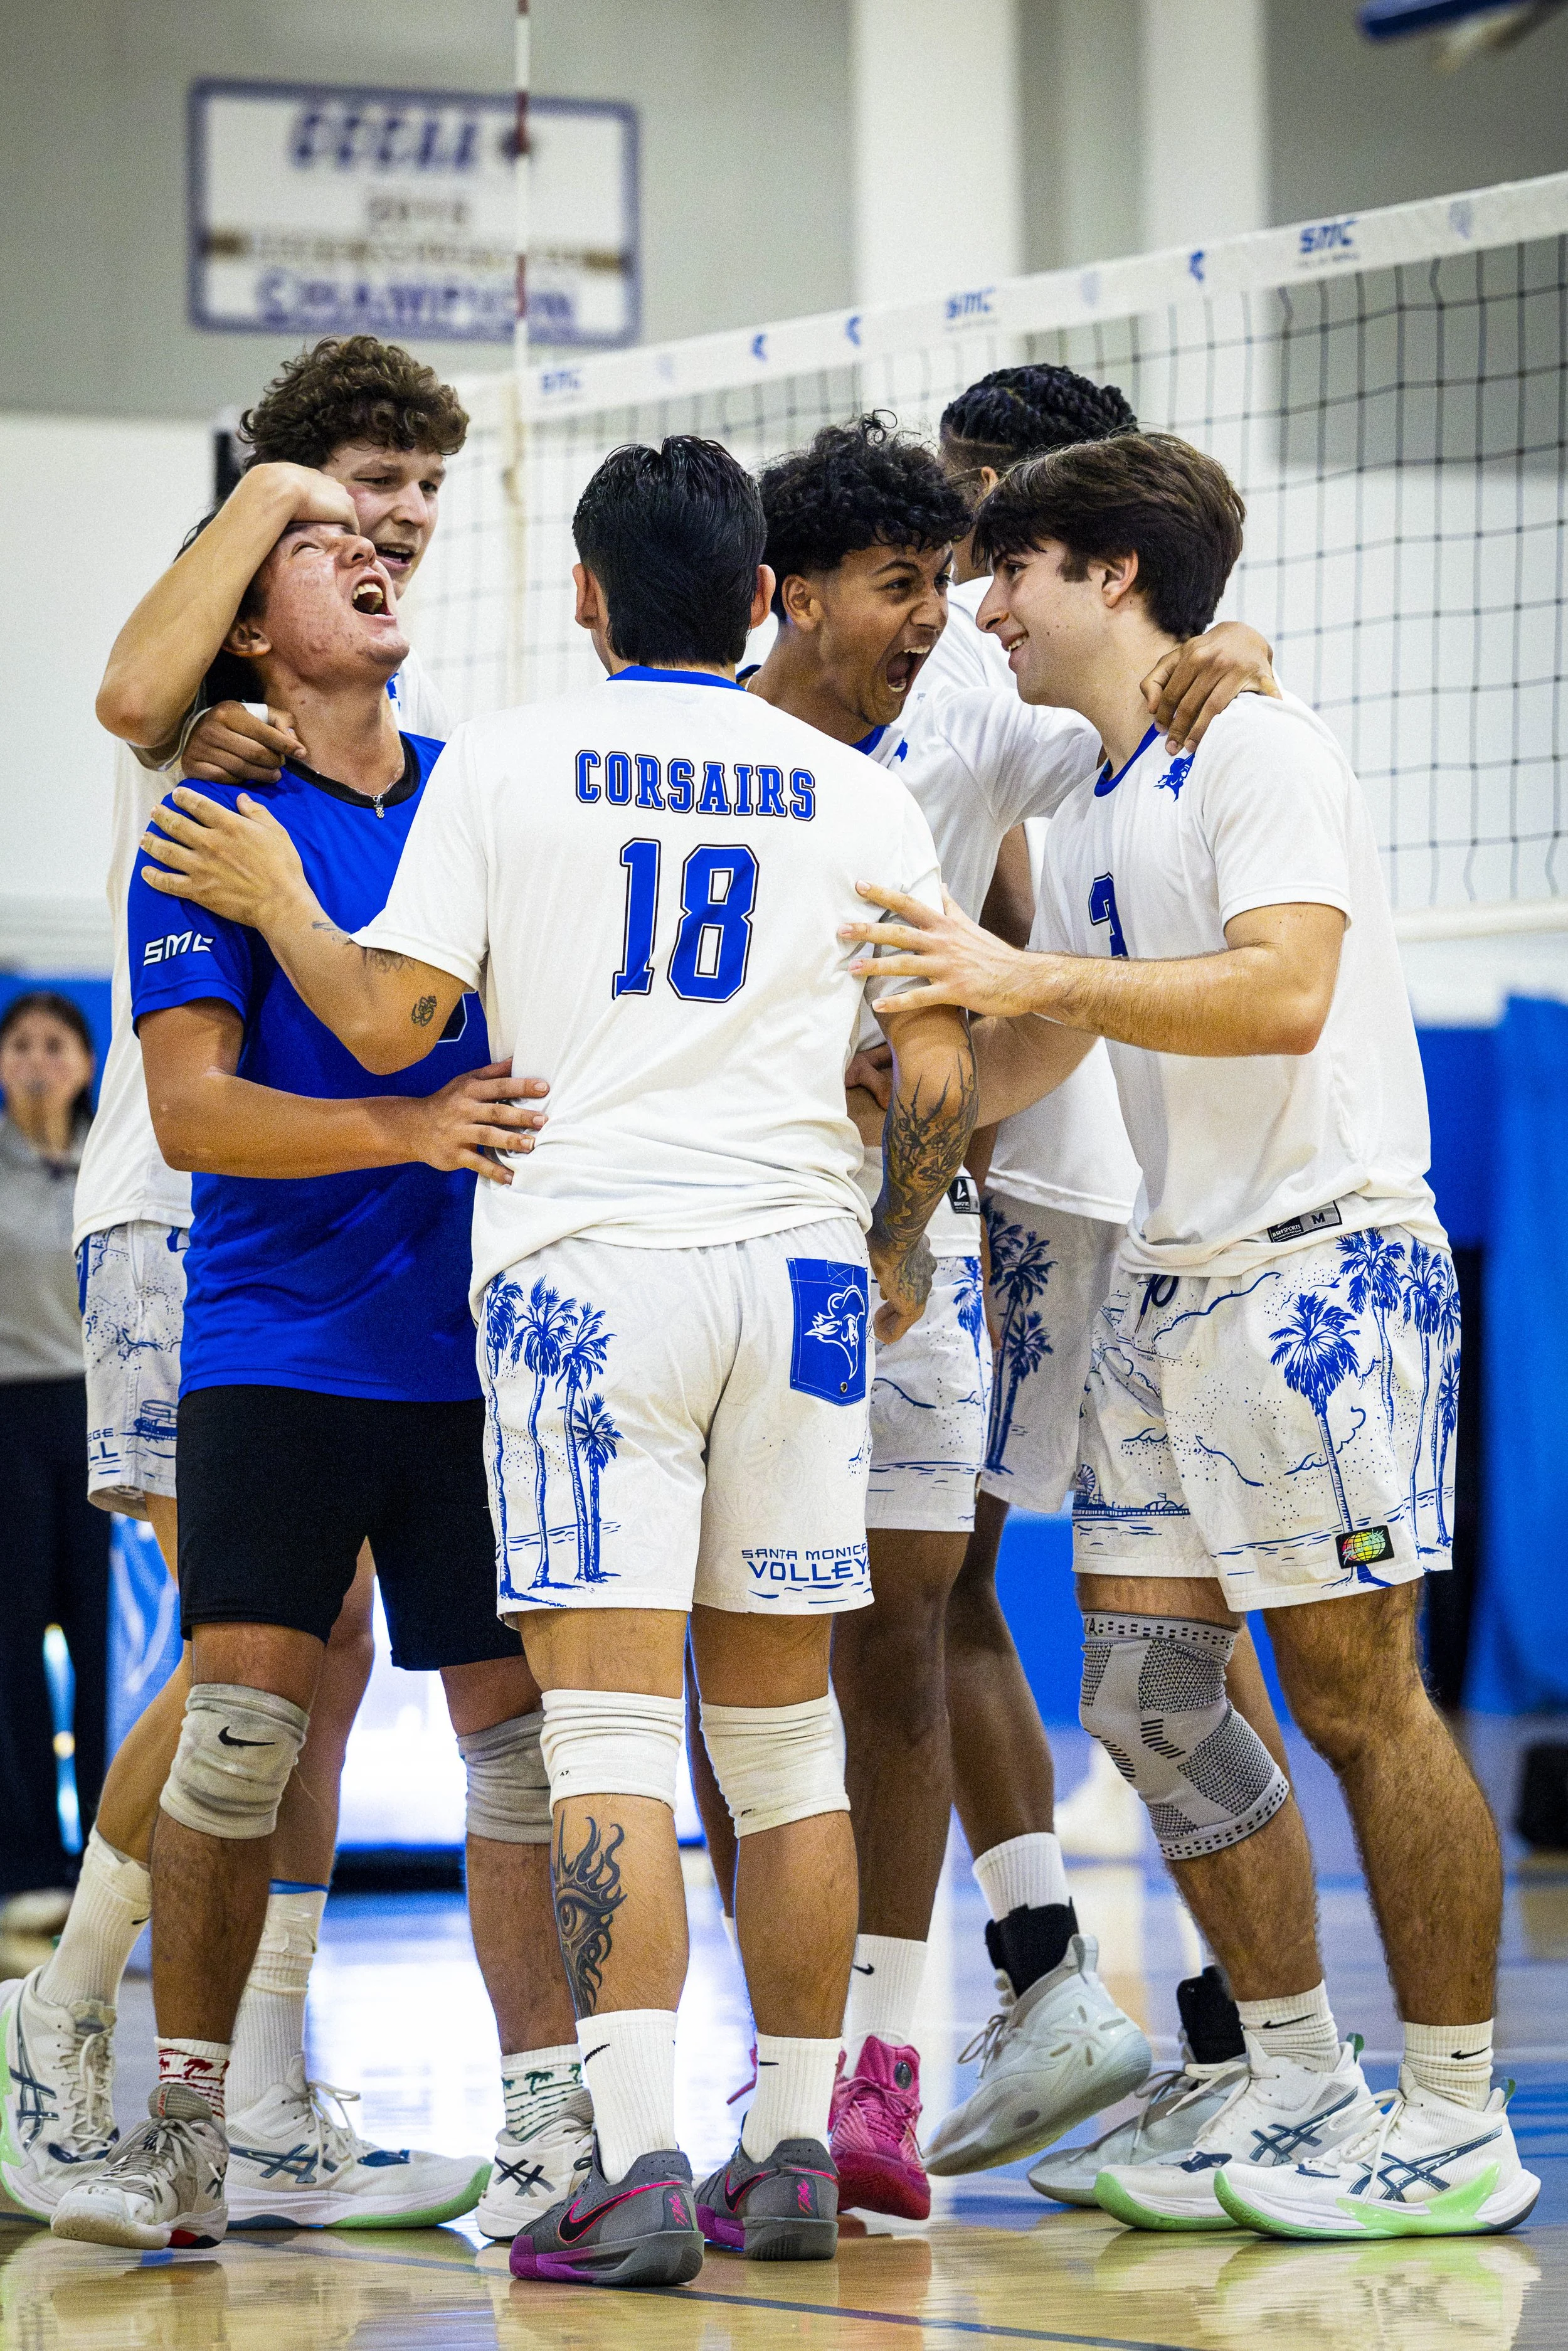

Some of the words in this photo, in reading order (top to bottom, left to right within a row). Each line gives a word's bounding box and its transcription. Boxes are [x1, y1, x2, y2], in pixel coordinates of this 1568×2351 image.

[1299, 219, 1359, 255] SMC
[575, 749, 815, 822] CORSAIRS
[612, 837, 760, 1004] 18
[142, 930, 215, 967] SMC
[1272, 1228, 1284, 1237] BSN
[1283, 1224, 1301, 1233] SPORTS
[1311, 1212, 1326, 1224] M
[741, 1548, 798, 1561] SANTA
